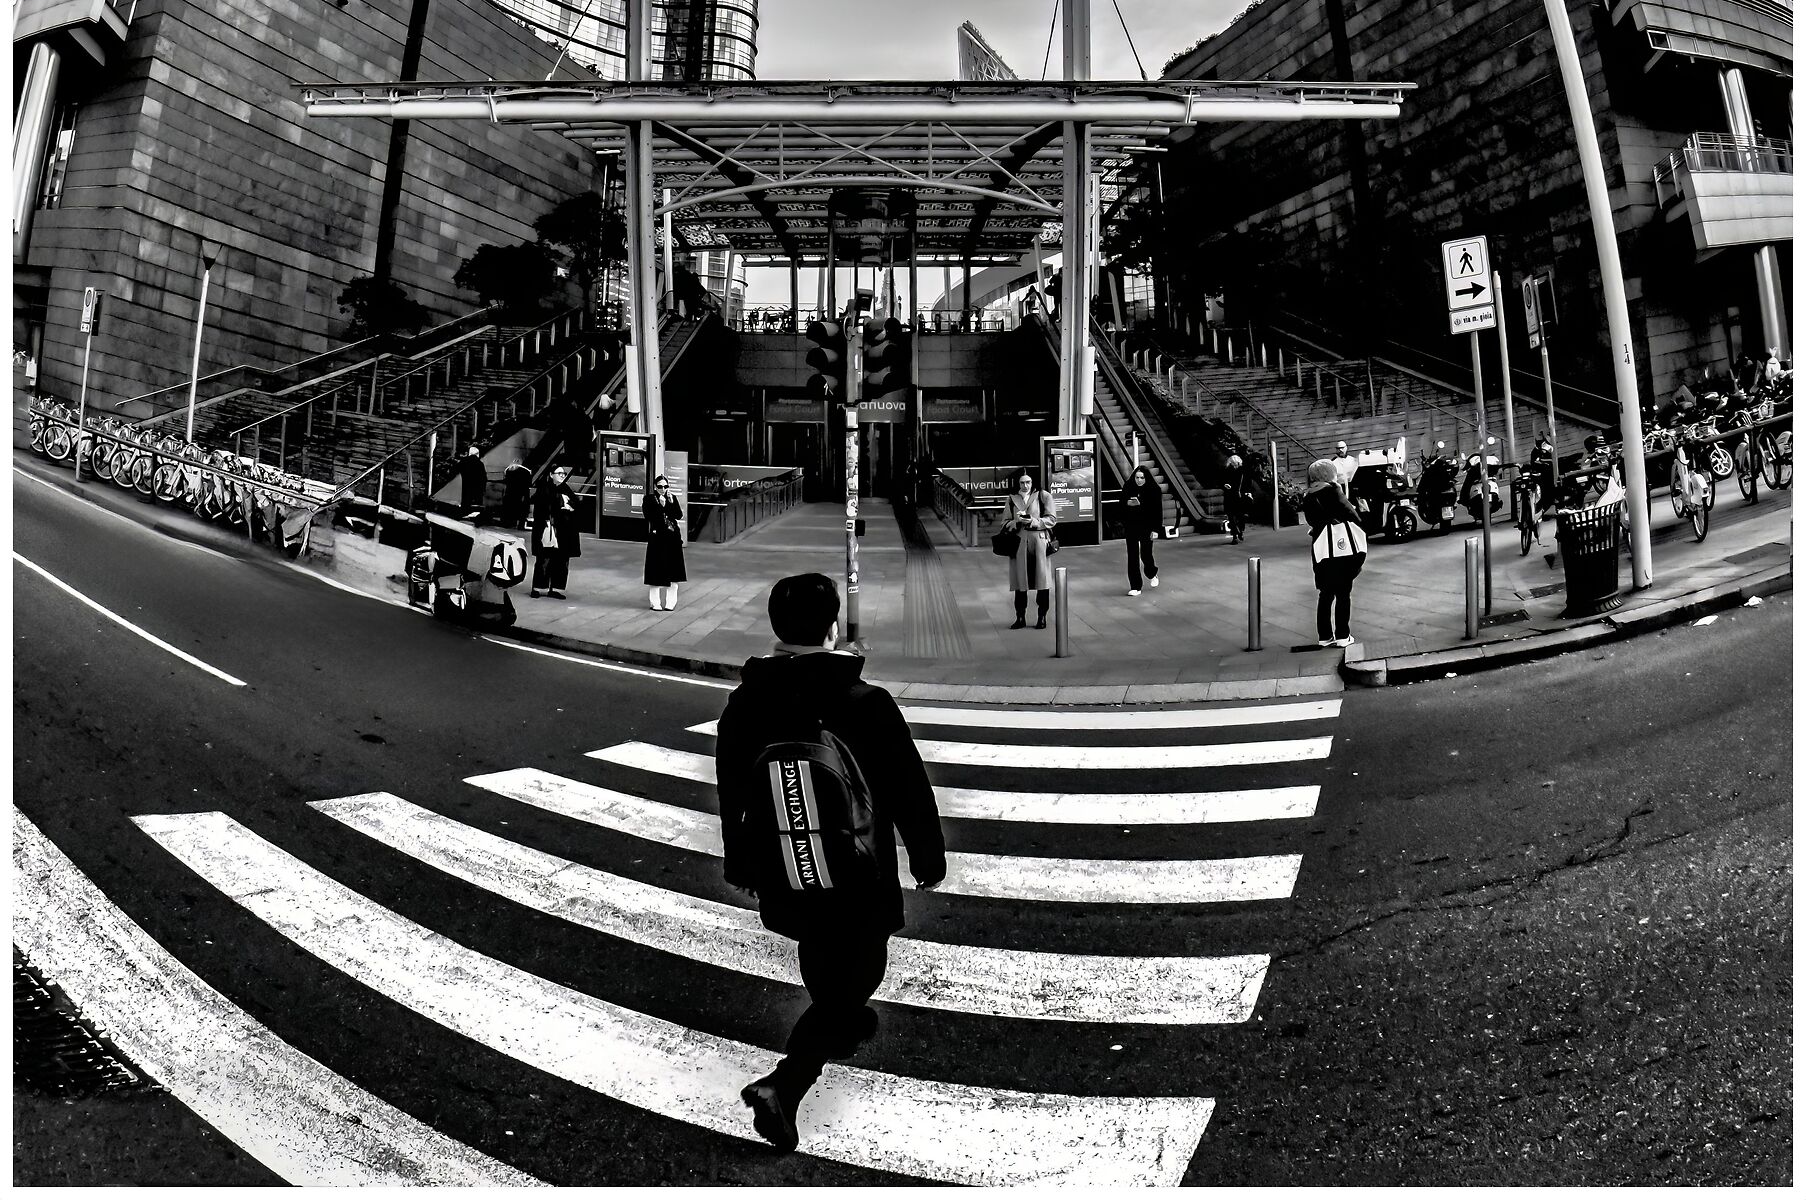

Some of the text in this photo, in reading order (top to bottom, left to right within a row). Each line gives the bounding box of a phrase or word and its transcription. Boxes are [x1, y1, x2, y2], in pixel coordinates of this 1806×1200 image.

[611, 482, 644, 490] Portanuova
[1057, 487, 1092, 495] Portanuova
[783, 761, 815, 885] ARMANI EXCHANGE
